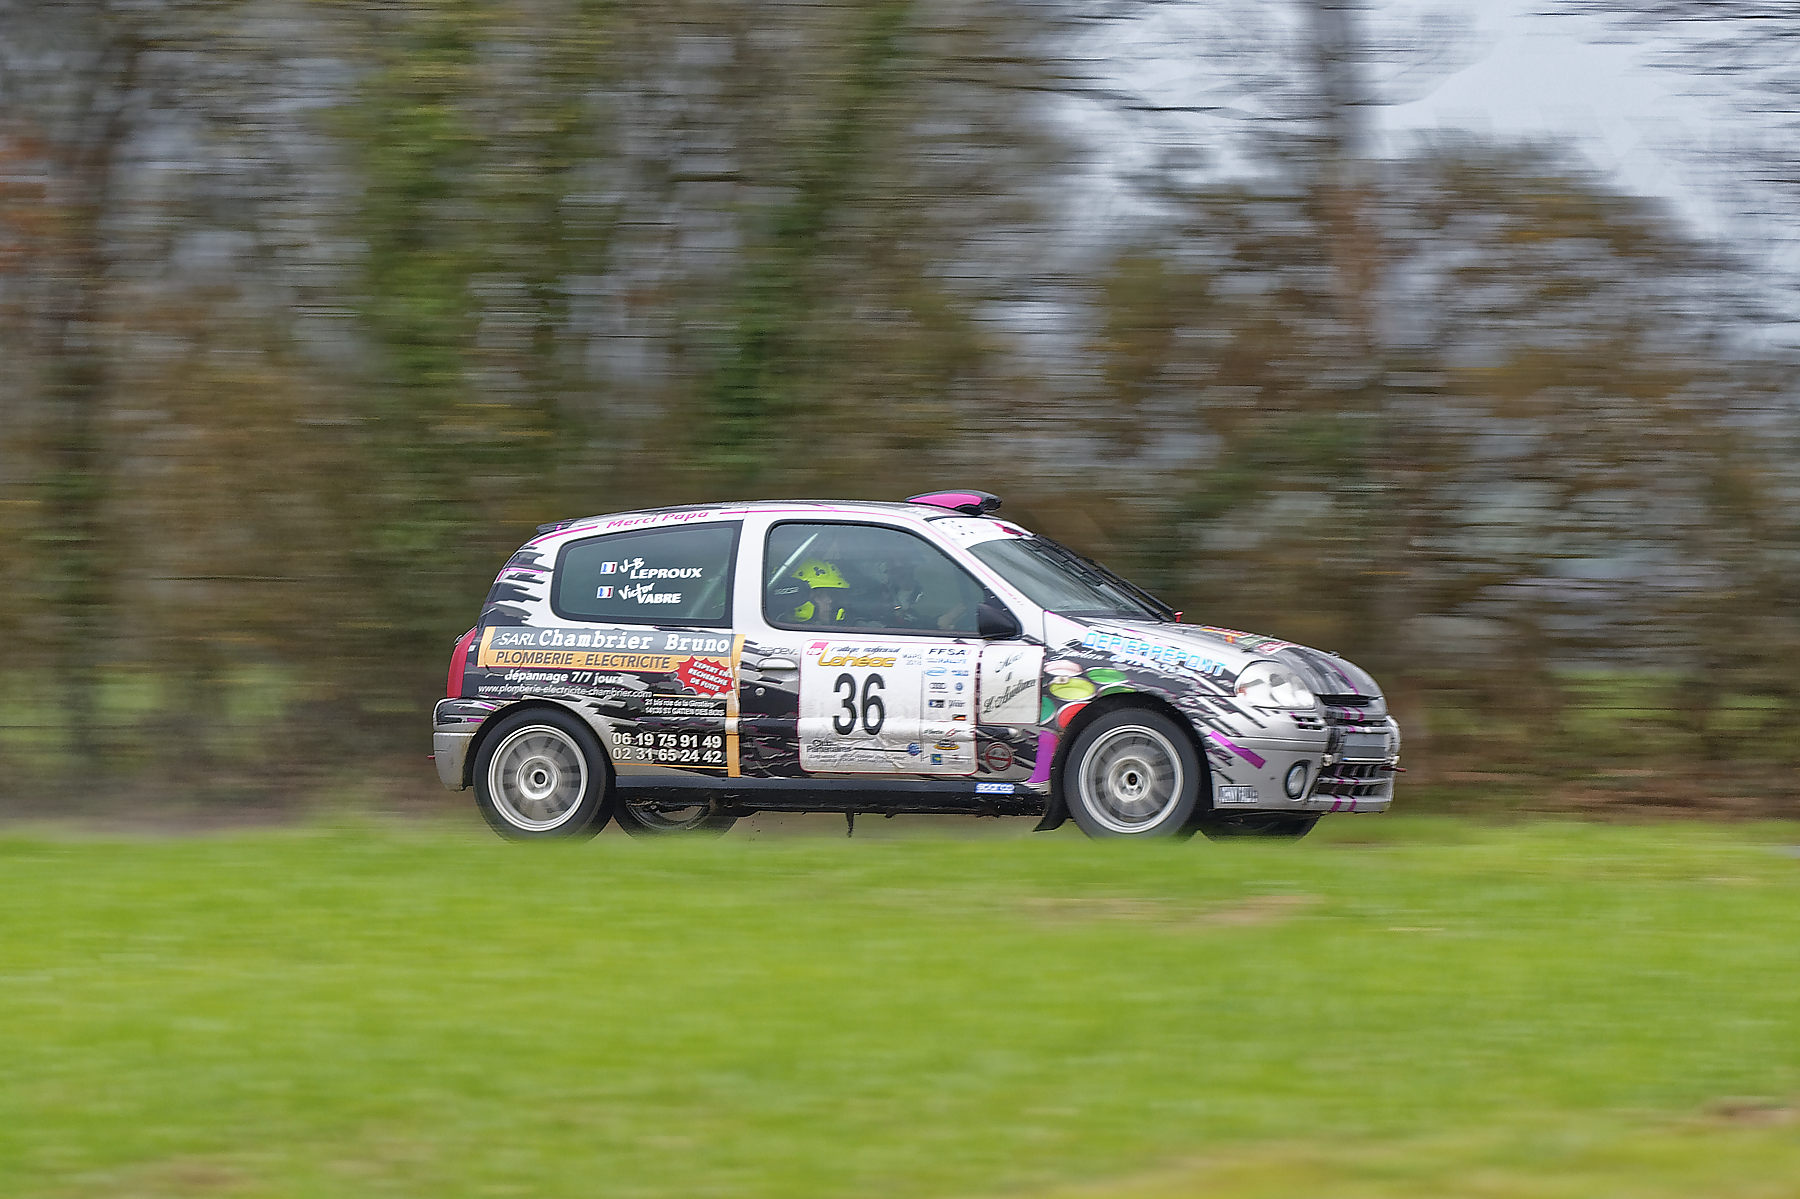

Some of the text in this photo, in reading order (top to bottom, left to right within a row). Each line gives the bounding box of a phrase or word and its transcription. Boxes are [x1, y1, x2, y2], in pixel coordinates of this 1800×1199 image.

[606, 511, 709, 529] Merci Papa
[619, 558, 645, 573] J-B
[629, 568, 703, 580] LEPROUX
[618, 582, 655, 600] Victor
[637, 593, 682, 605] VABRE
[498, 629, 730, 653] SARL Chambrier Bruno
[495, 651, 574, 665] PLOMBERIE
[584, 653, 671, 669] ELECTRICITE
[817, 648, 896, 667] Lohéac
[928, 648, 967, 656] FFSA
[504, 669, 624, 686] dépannage 7/7 jours
[832, 672, 886, 735] 36
[612, 732, 722, 749] 06 19 75 91 49
[612, 747, 722, 763] 02 31 65 24 42
